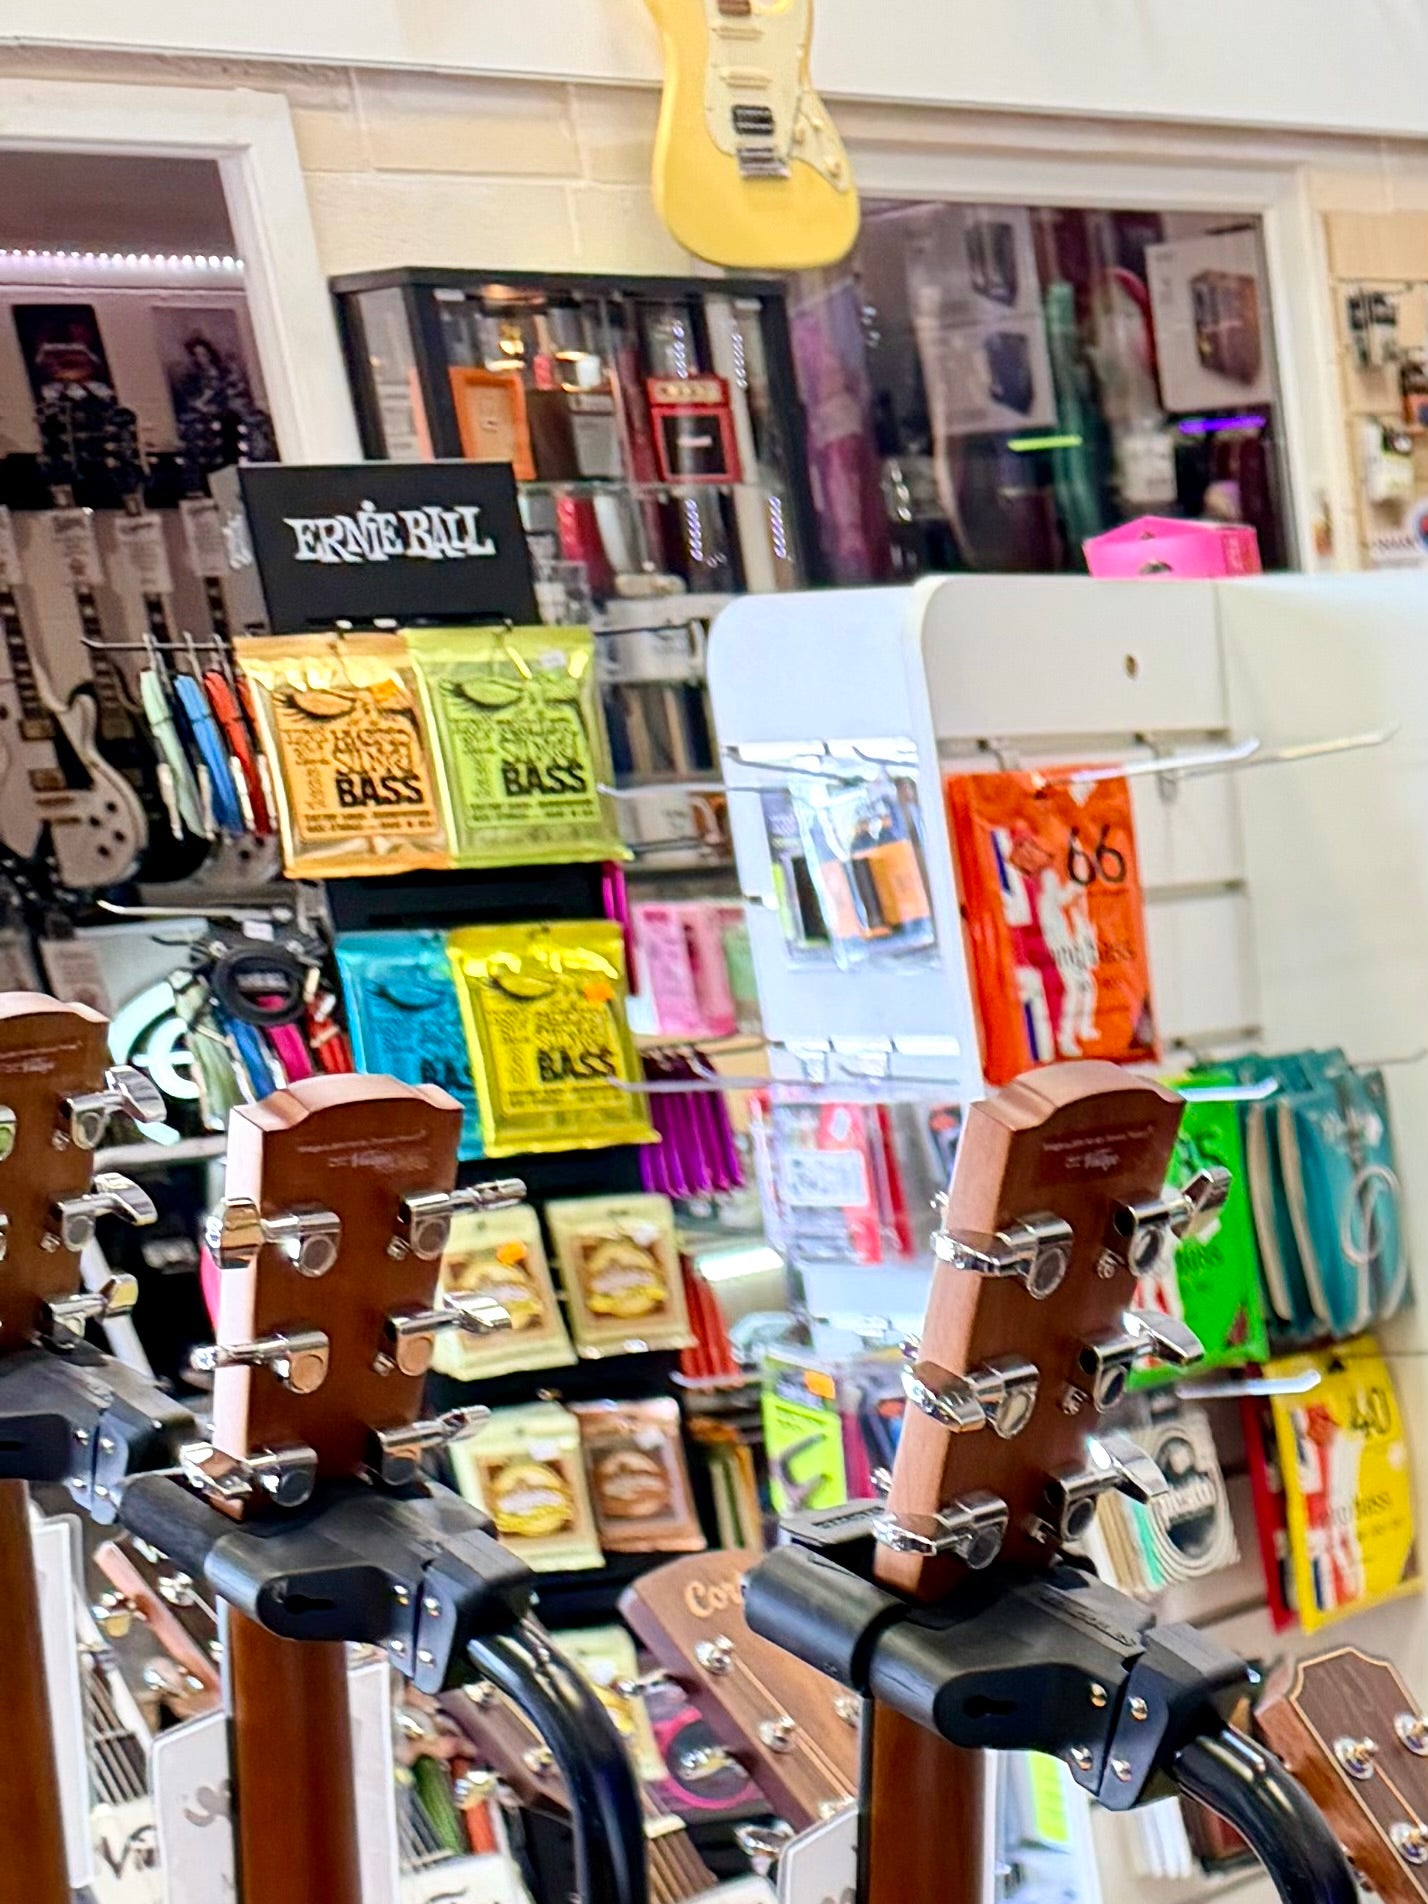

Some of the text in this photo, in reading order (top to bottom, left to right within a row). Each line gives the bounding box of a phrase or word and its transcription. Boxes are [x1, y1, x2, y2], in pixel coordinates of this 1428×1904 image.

[283, 501, 497, 564] ERNIE BALL
[335, 775, 425, 808] BASS
[502, 758, 588, 796] BASS
[1067, 823, 1127, 886] 66
[538, 1048, 618, 1082] BASS
[687, 1578, 745, 1619] Cor
